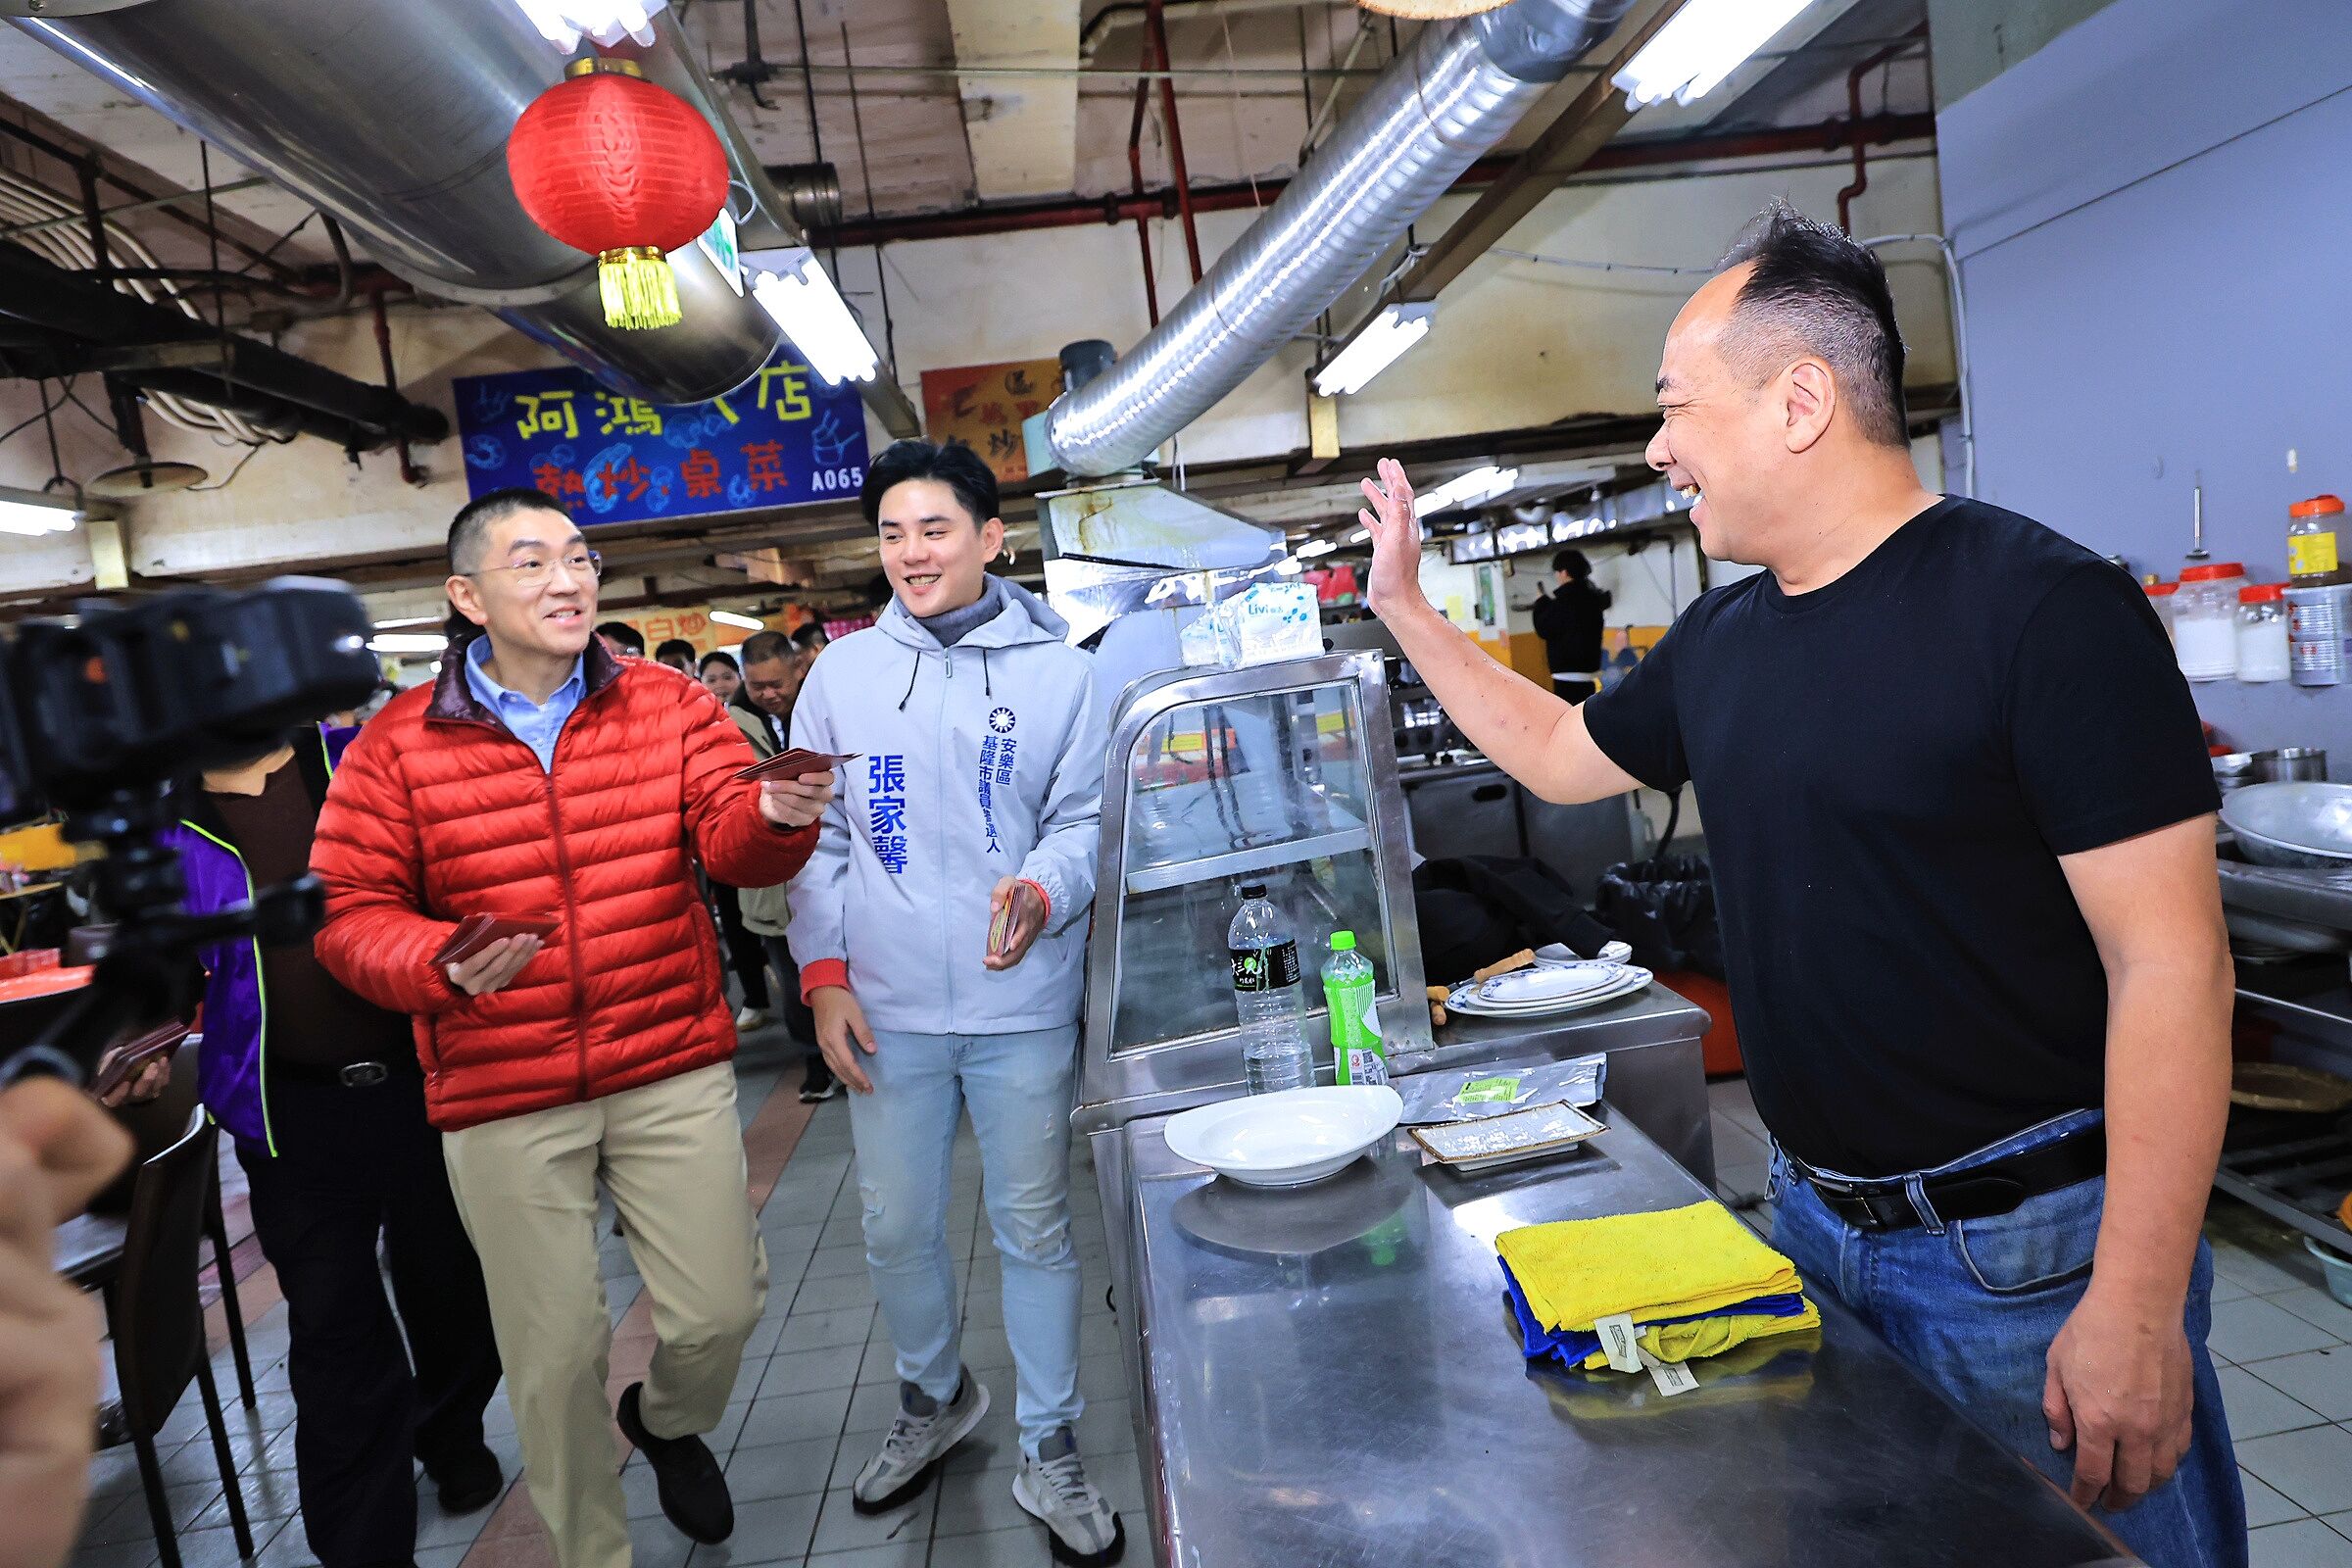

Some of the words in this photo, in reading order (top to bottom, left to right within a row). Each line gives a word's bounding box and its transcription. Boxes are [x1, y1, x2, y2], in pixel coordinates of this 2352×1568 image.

[514, 360, 812, 440] 阿鴻店
[811, 466, 863, 492] A065
[995, 737, 1017, 786] 安樂區
[868, 755, 908, 874] 張家馨
